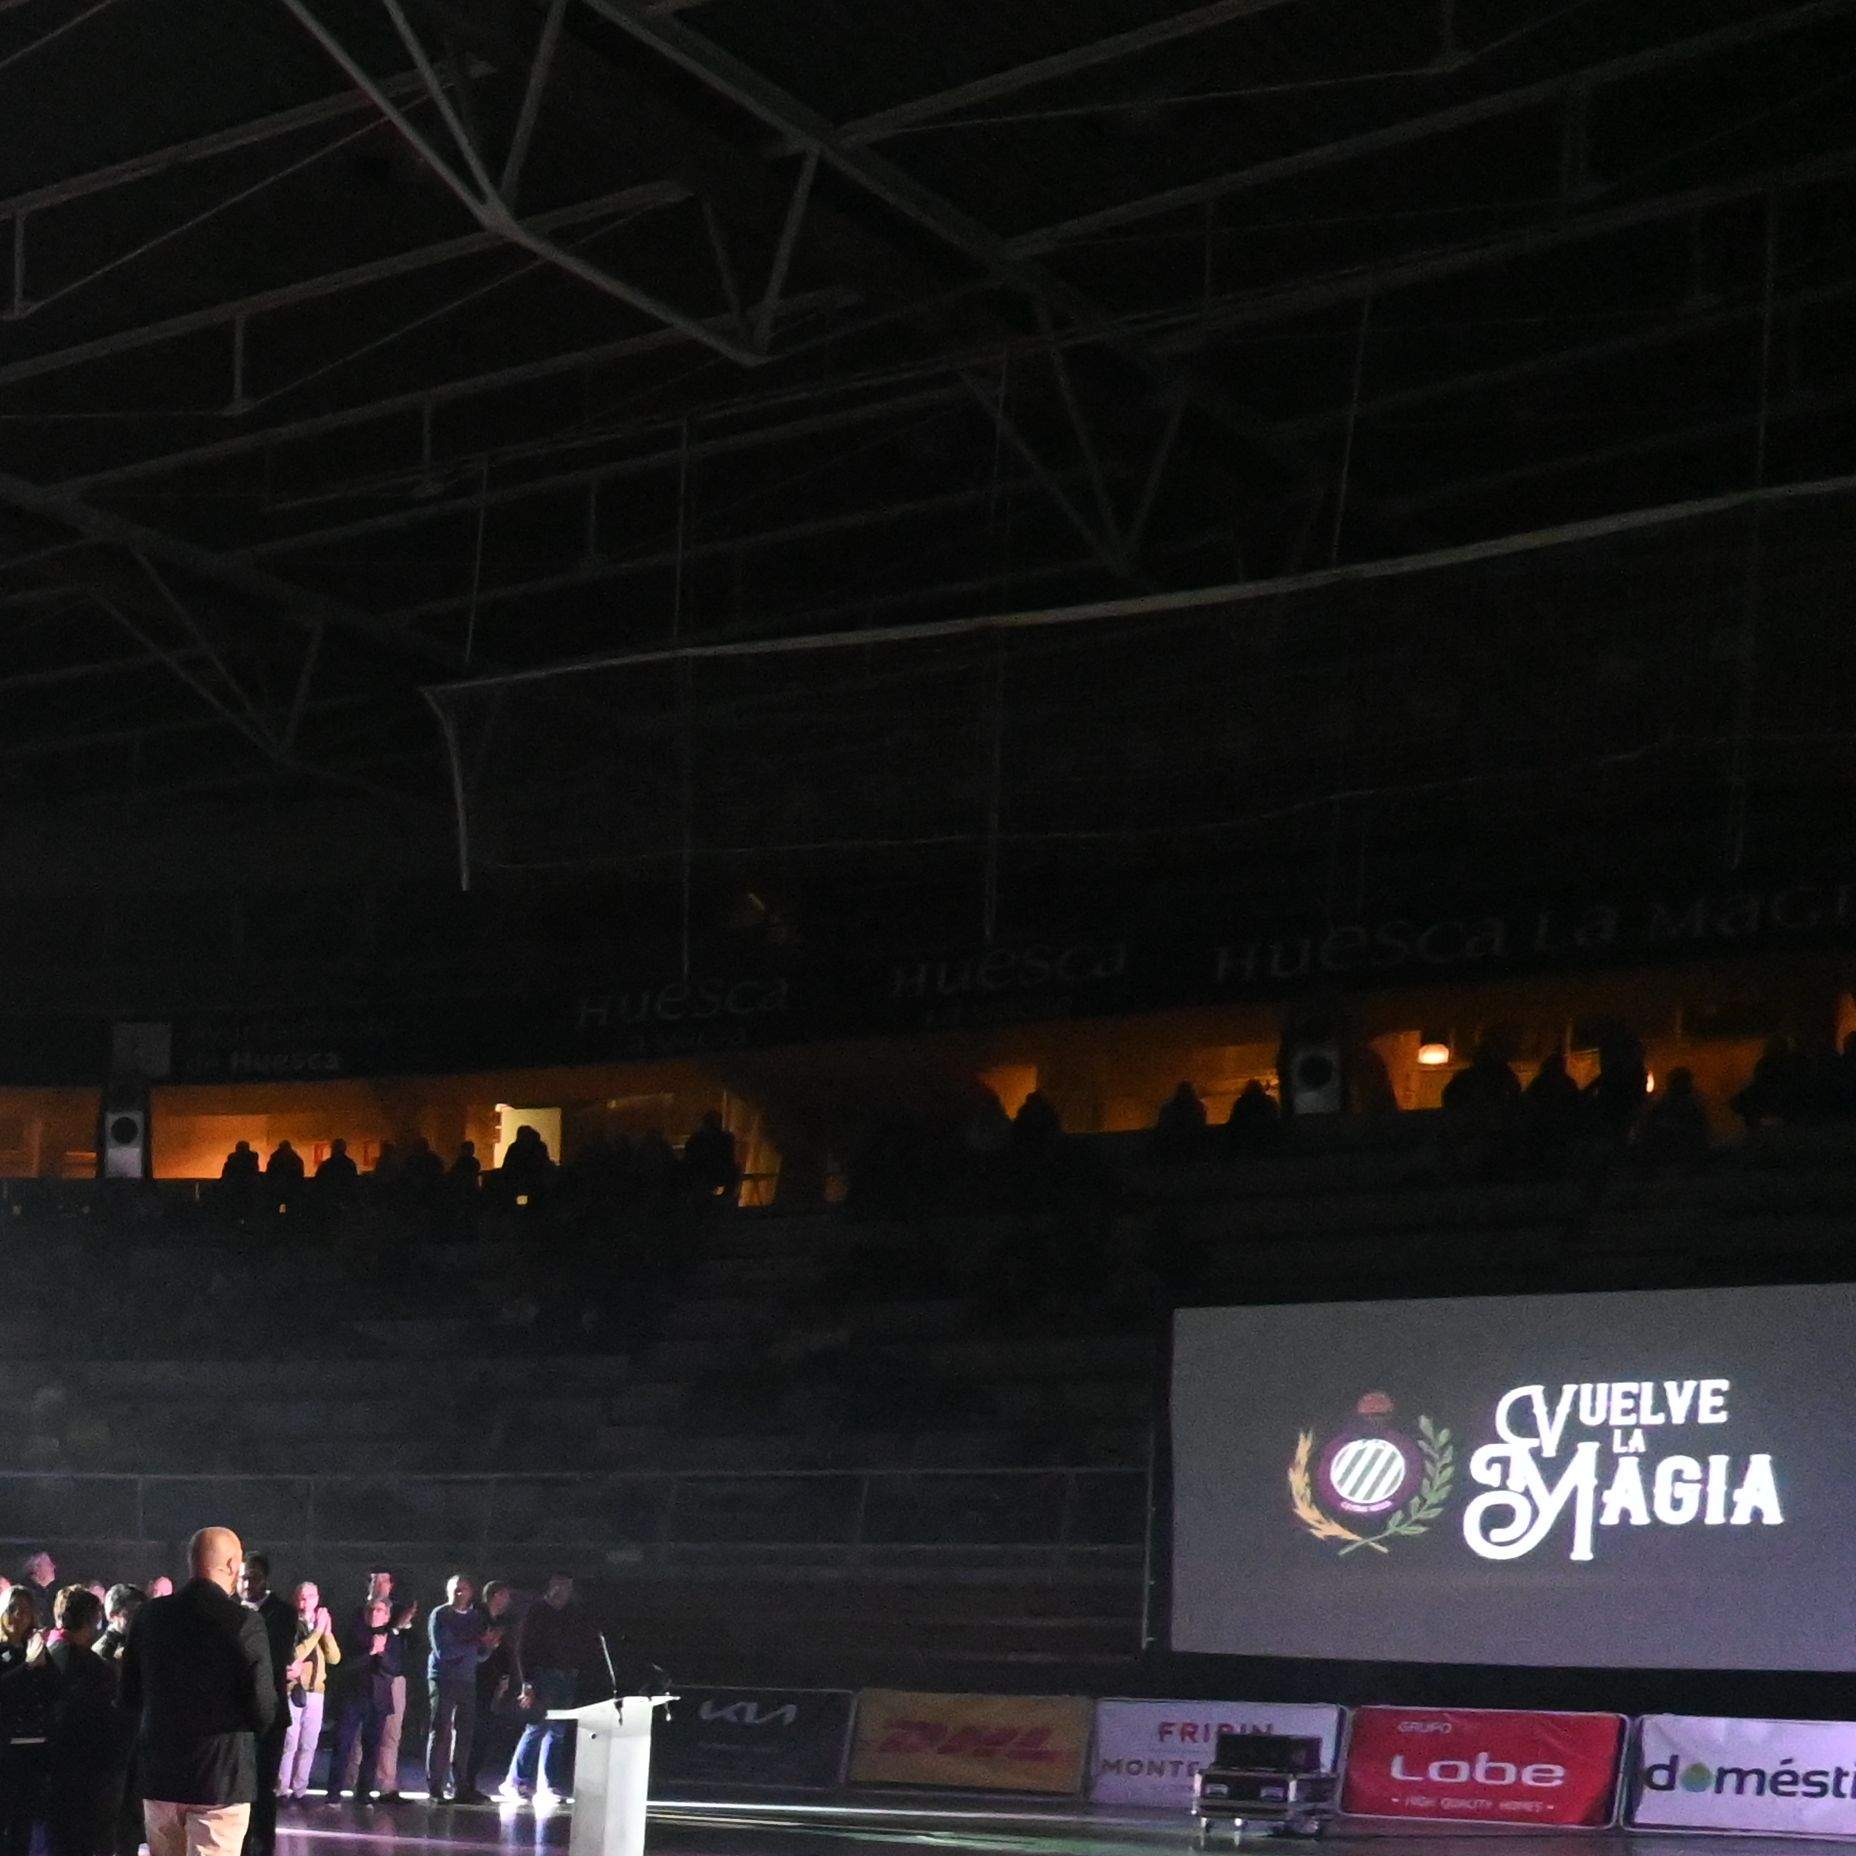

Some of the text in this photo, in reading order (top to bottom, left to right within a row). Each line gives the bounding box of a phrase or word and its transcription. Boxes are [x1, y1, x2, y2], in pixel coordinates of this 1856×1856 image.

[1496, 1379, 1730, 1457] VUELVE
[1612, 1429, 1646, 1453] LA
[1463, 1441, 1784, 1560] MAGIA
[880, 1720, 1056, 1762] DHL
[1390, 1752, 1566, 1787] Lobe
